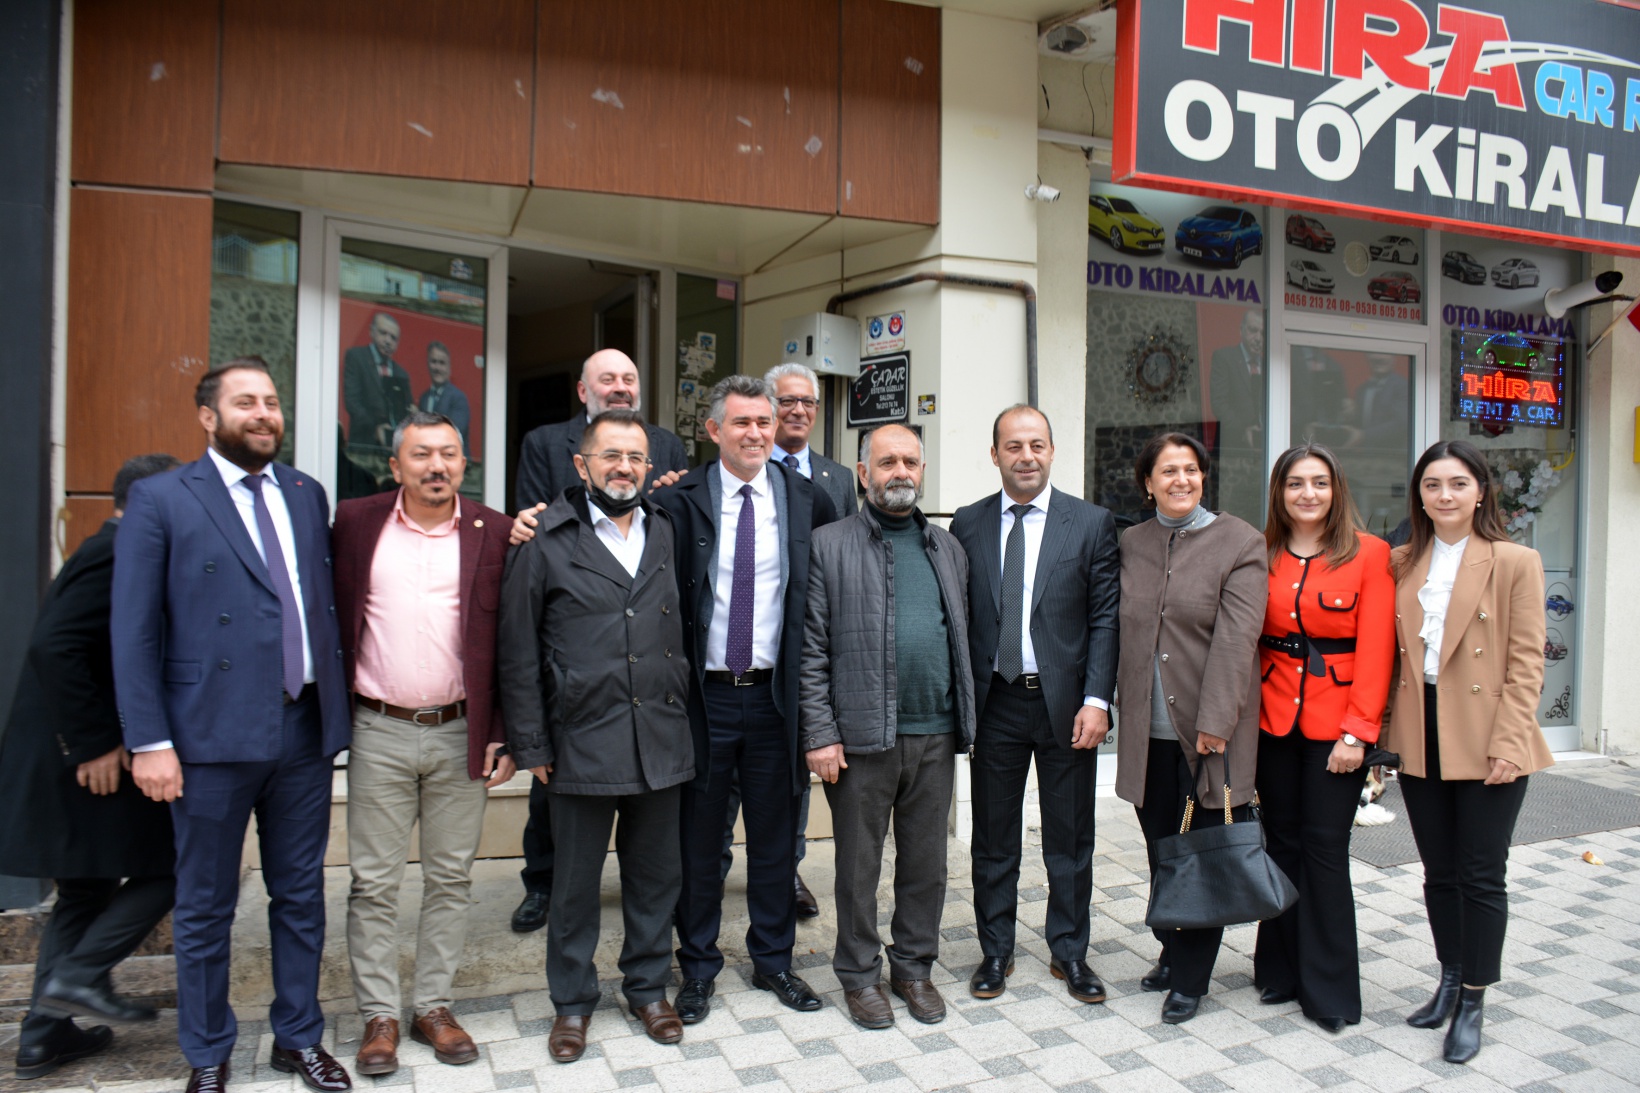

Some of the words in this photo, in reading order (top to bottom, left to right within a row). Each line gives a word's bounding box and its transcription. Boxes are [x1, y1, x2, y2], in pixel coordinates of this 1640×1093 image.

[1535, 61, 1614, 128] CAR
[1164, 79, 1363, 181] OTO
[1087, 260, 1133, 288] OTO
[1309, 296, 1324, 309] 213
[1326, 298, 1337, 310] 24
[1410, 308, 1420, 320] 04
[1443, 304, 1480, 326] OTO
[1463, 399, 1504, 416] RENT
[1511, 404, 1521, 417] A
[1527, 405, 1555, 420] CAR
